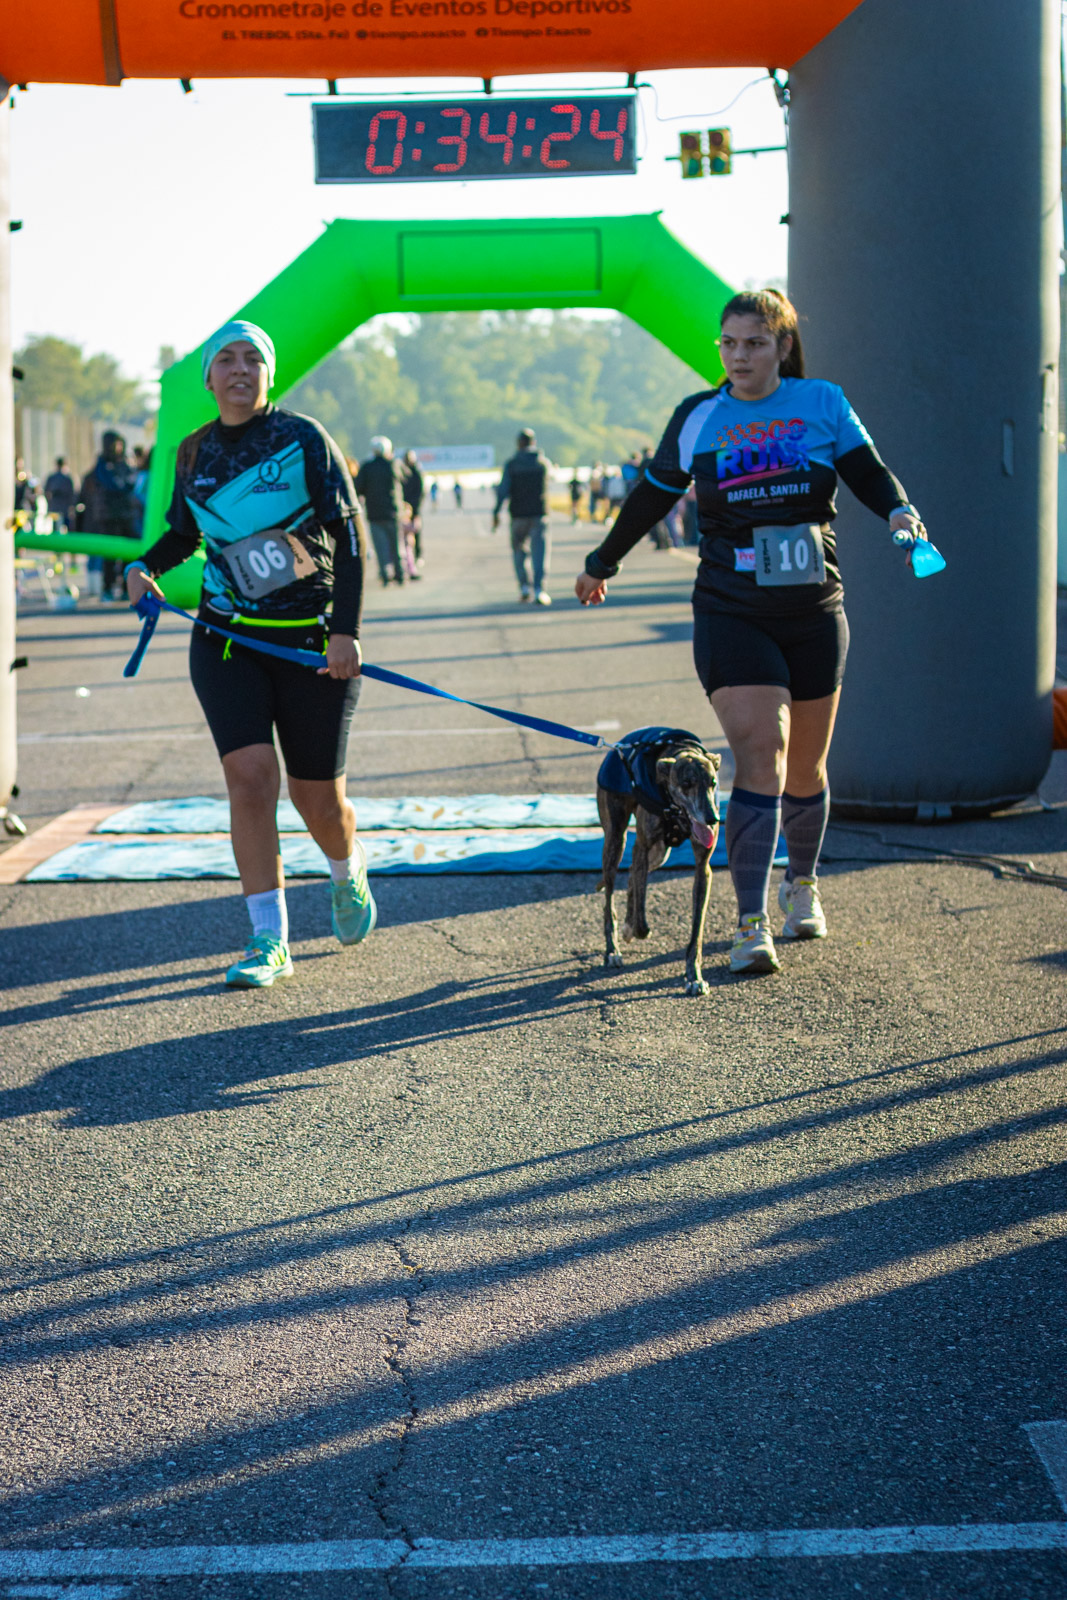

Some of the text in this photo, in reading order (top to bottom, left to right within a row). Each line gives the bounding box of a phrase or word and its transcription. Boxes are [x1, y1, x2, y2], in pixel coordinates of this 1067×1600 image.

[179, 0, 632, 21] Cronometraje de Eventos Deportivos
[491, 27, 592, 38] Tiempo Exacto
[365, 104, 628, 174] 0:34:24
[716, 441, 800, 479] RUN
[727, 486, 768, 503] RAFAELA,
[770, 483, 799, 497] SANTA
[800, 482, 811, 494] FE
[248, 540, 287, 579] 06
[779, 538, 809, 571] 10
